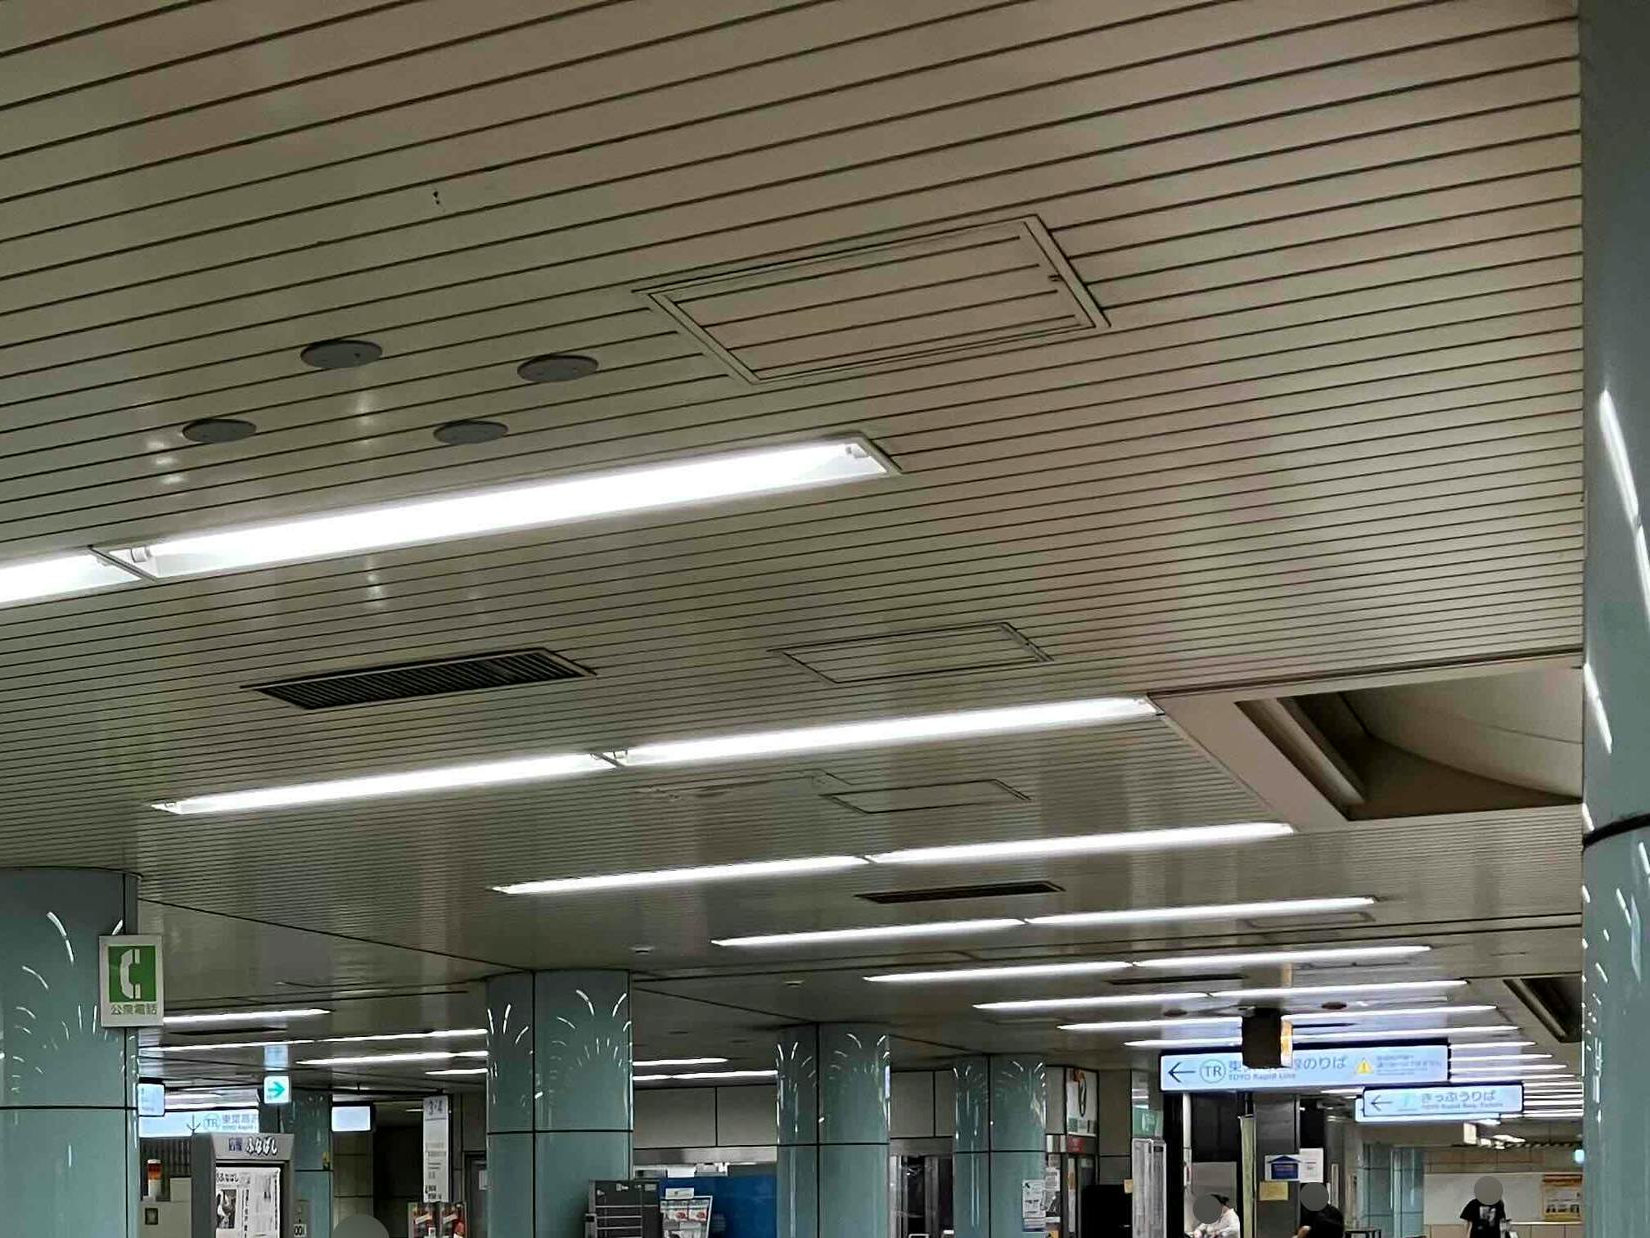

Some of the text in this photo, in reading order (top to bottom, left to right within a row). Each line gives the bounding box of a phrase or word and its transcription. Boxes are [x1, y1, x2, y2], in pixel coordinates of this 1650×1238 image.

[110, 1003, 157, 1016] 公衆電話
[1203, 1065, 1223, 1078] TR
[1421, 1089, 1497, 1104] きっぷうりば
